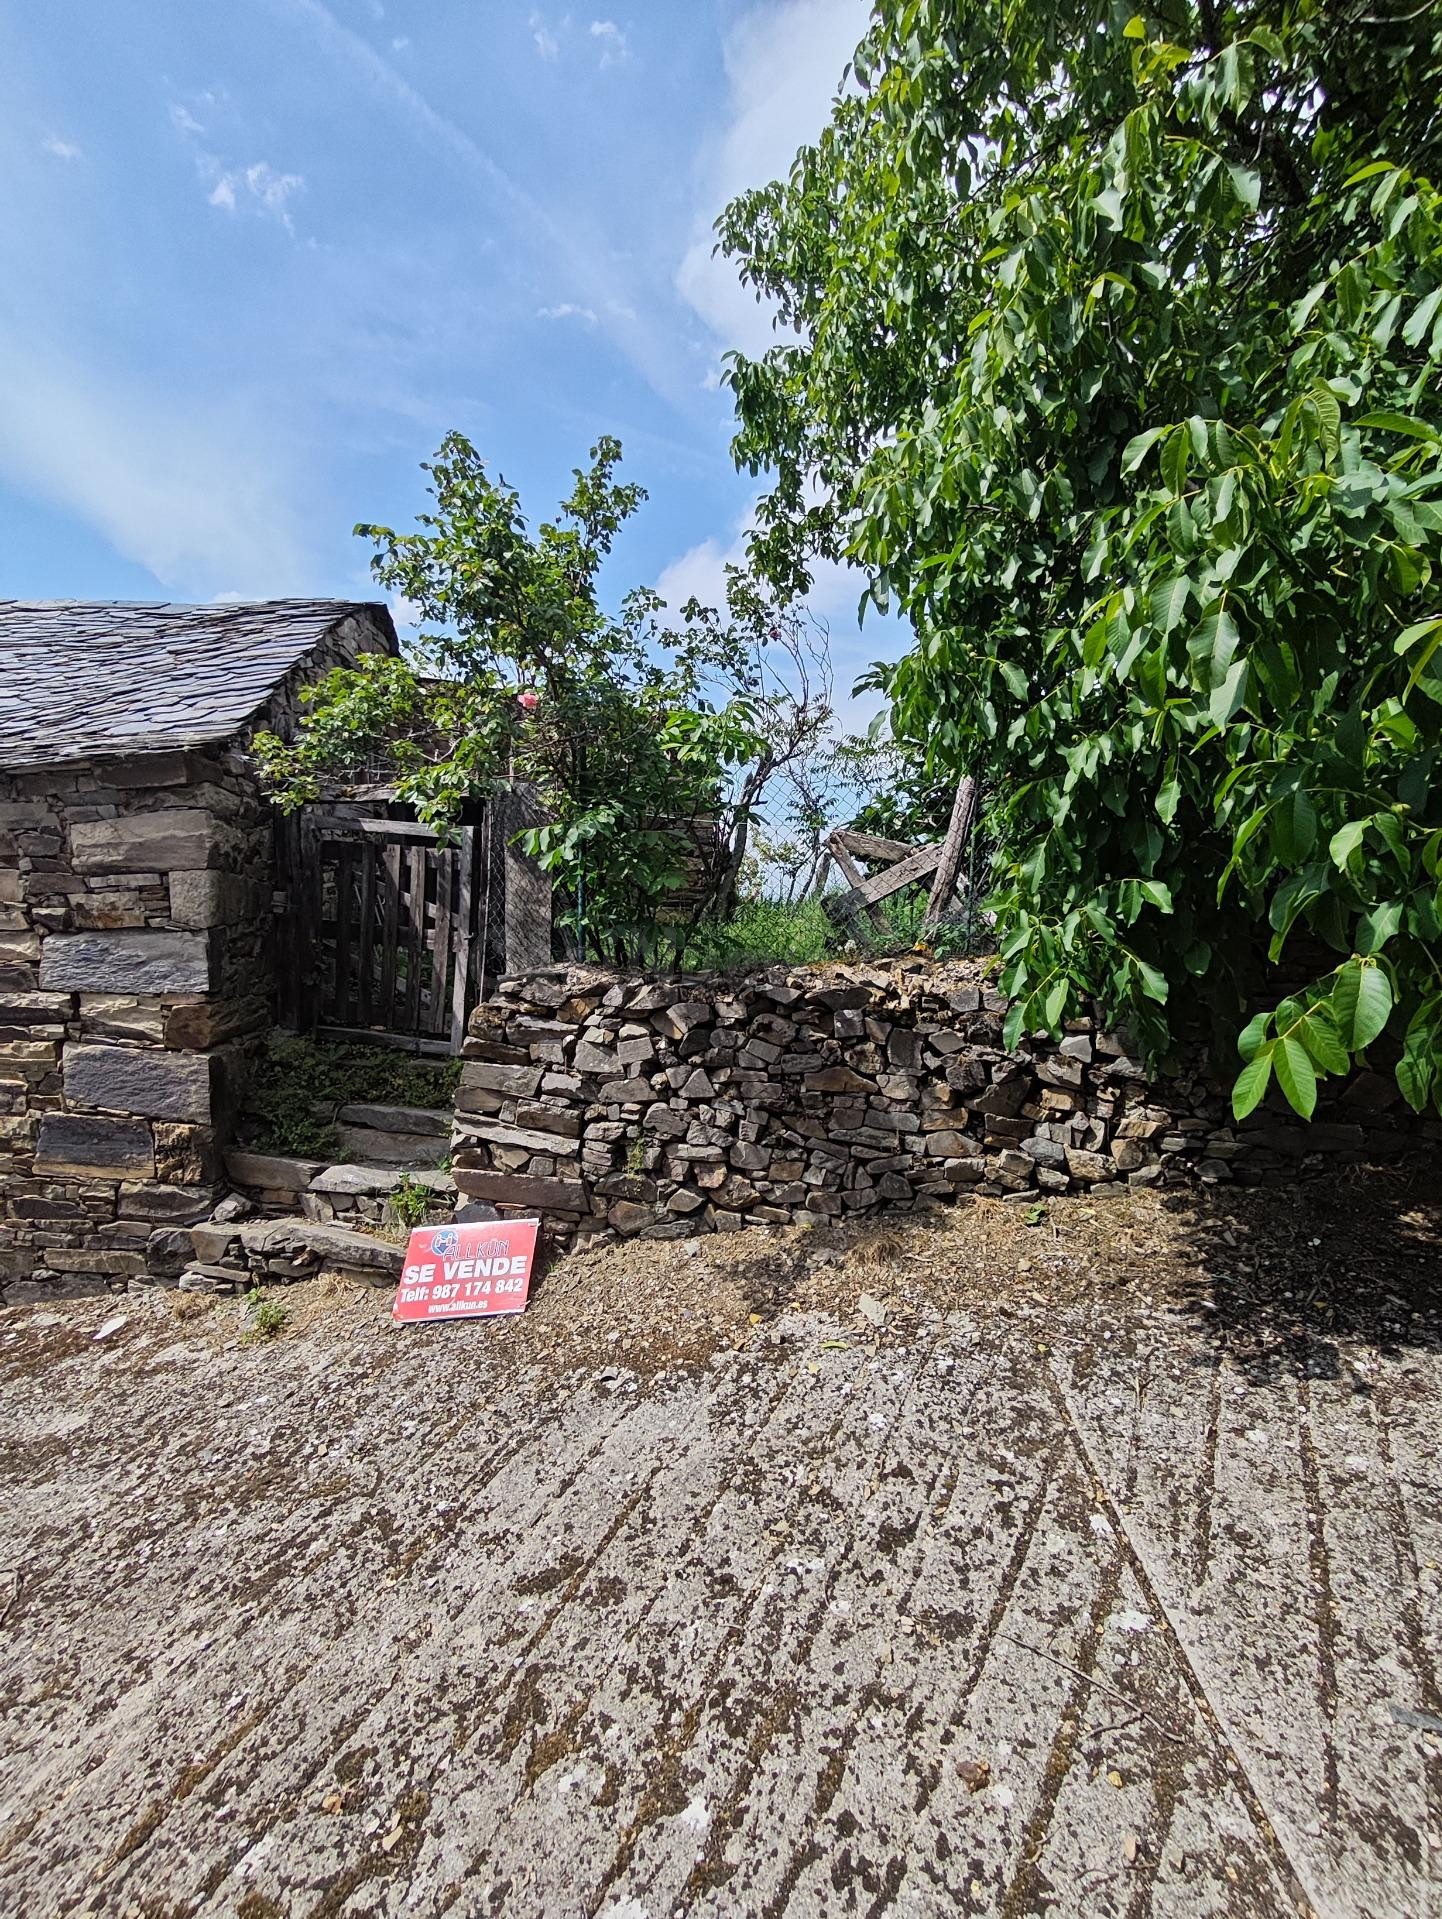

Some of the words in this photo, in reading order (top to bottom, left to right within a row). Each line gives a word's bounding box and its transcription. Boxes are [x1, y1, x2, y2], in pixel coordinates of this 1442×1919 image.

[403, 1264, 436, 1285] SE
[443, 1256, 527, 1280] VENDE
[400, 1288, 429, 1303] Telf:
[432, 1284, 460, 1299] 987
[464, 1281, 491, 1297] 174
[495, 1278, 523, 1293] 842
[428, 1300, 488, 1313] www.allkun.es
